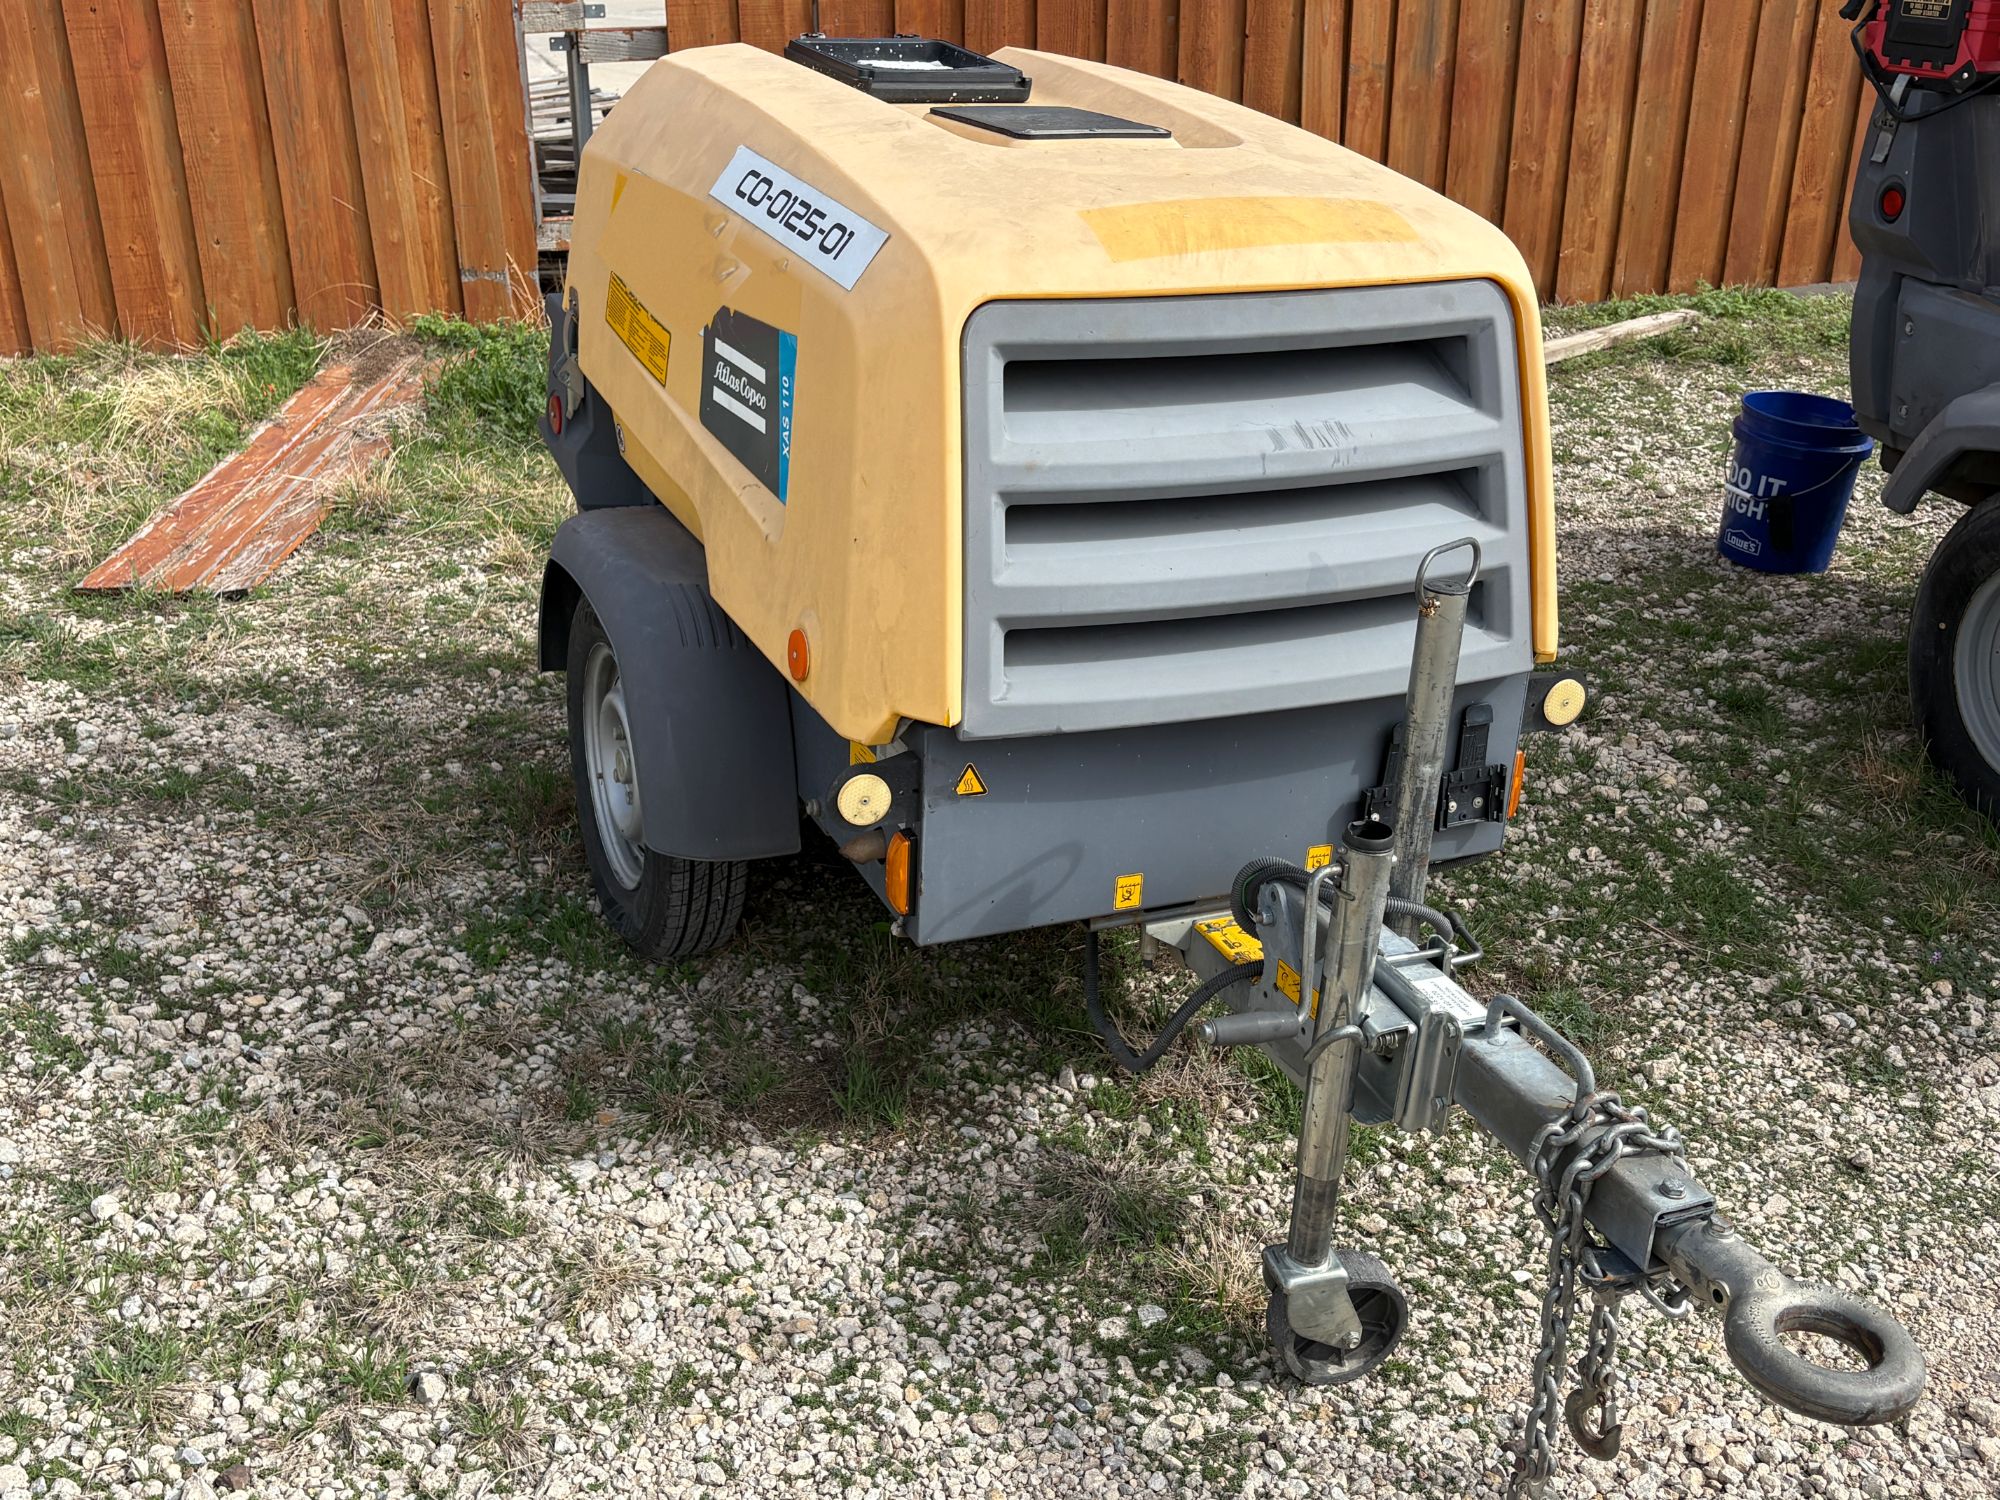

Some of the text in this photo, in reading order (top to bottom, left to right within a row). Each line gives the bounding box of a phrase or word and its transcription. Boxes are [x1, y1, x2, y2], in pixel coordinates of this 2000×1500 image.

[735, 169, 855, 260] CO-0125-01
[782, 375, 790, 459] XAS 110
[1726, 489, 1769, 523] RIGH
[1757, 475, 1787, 497] IT
